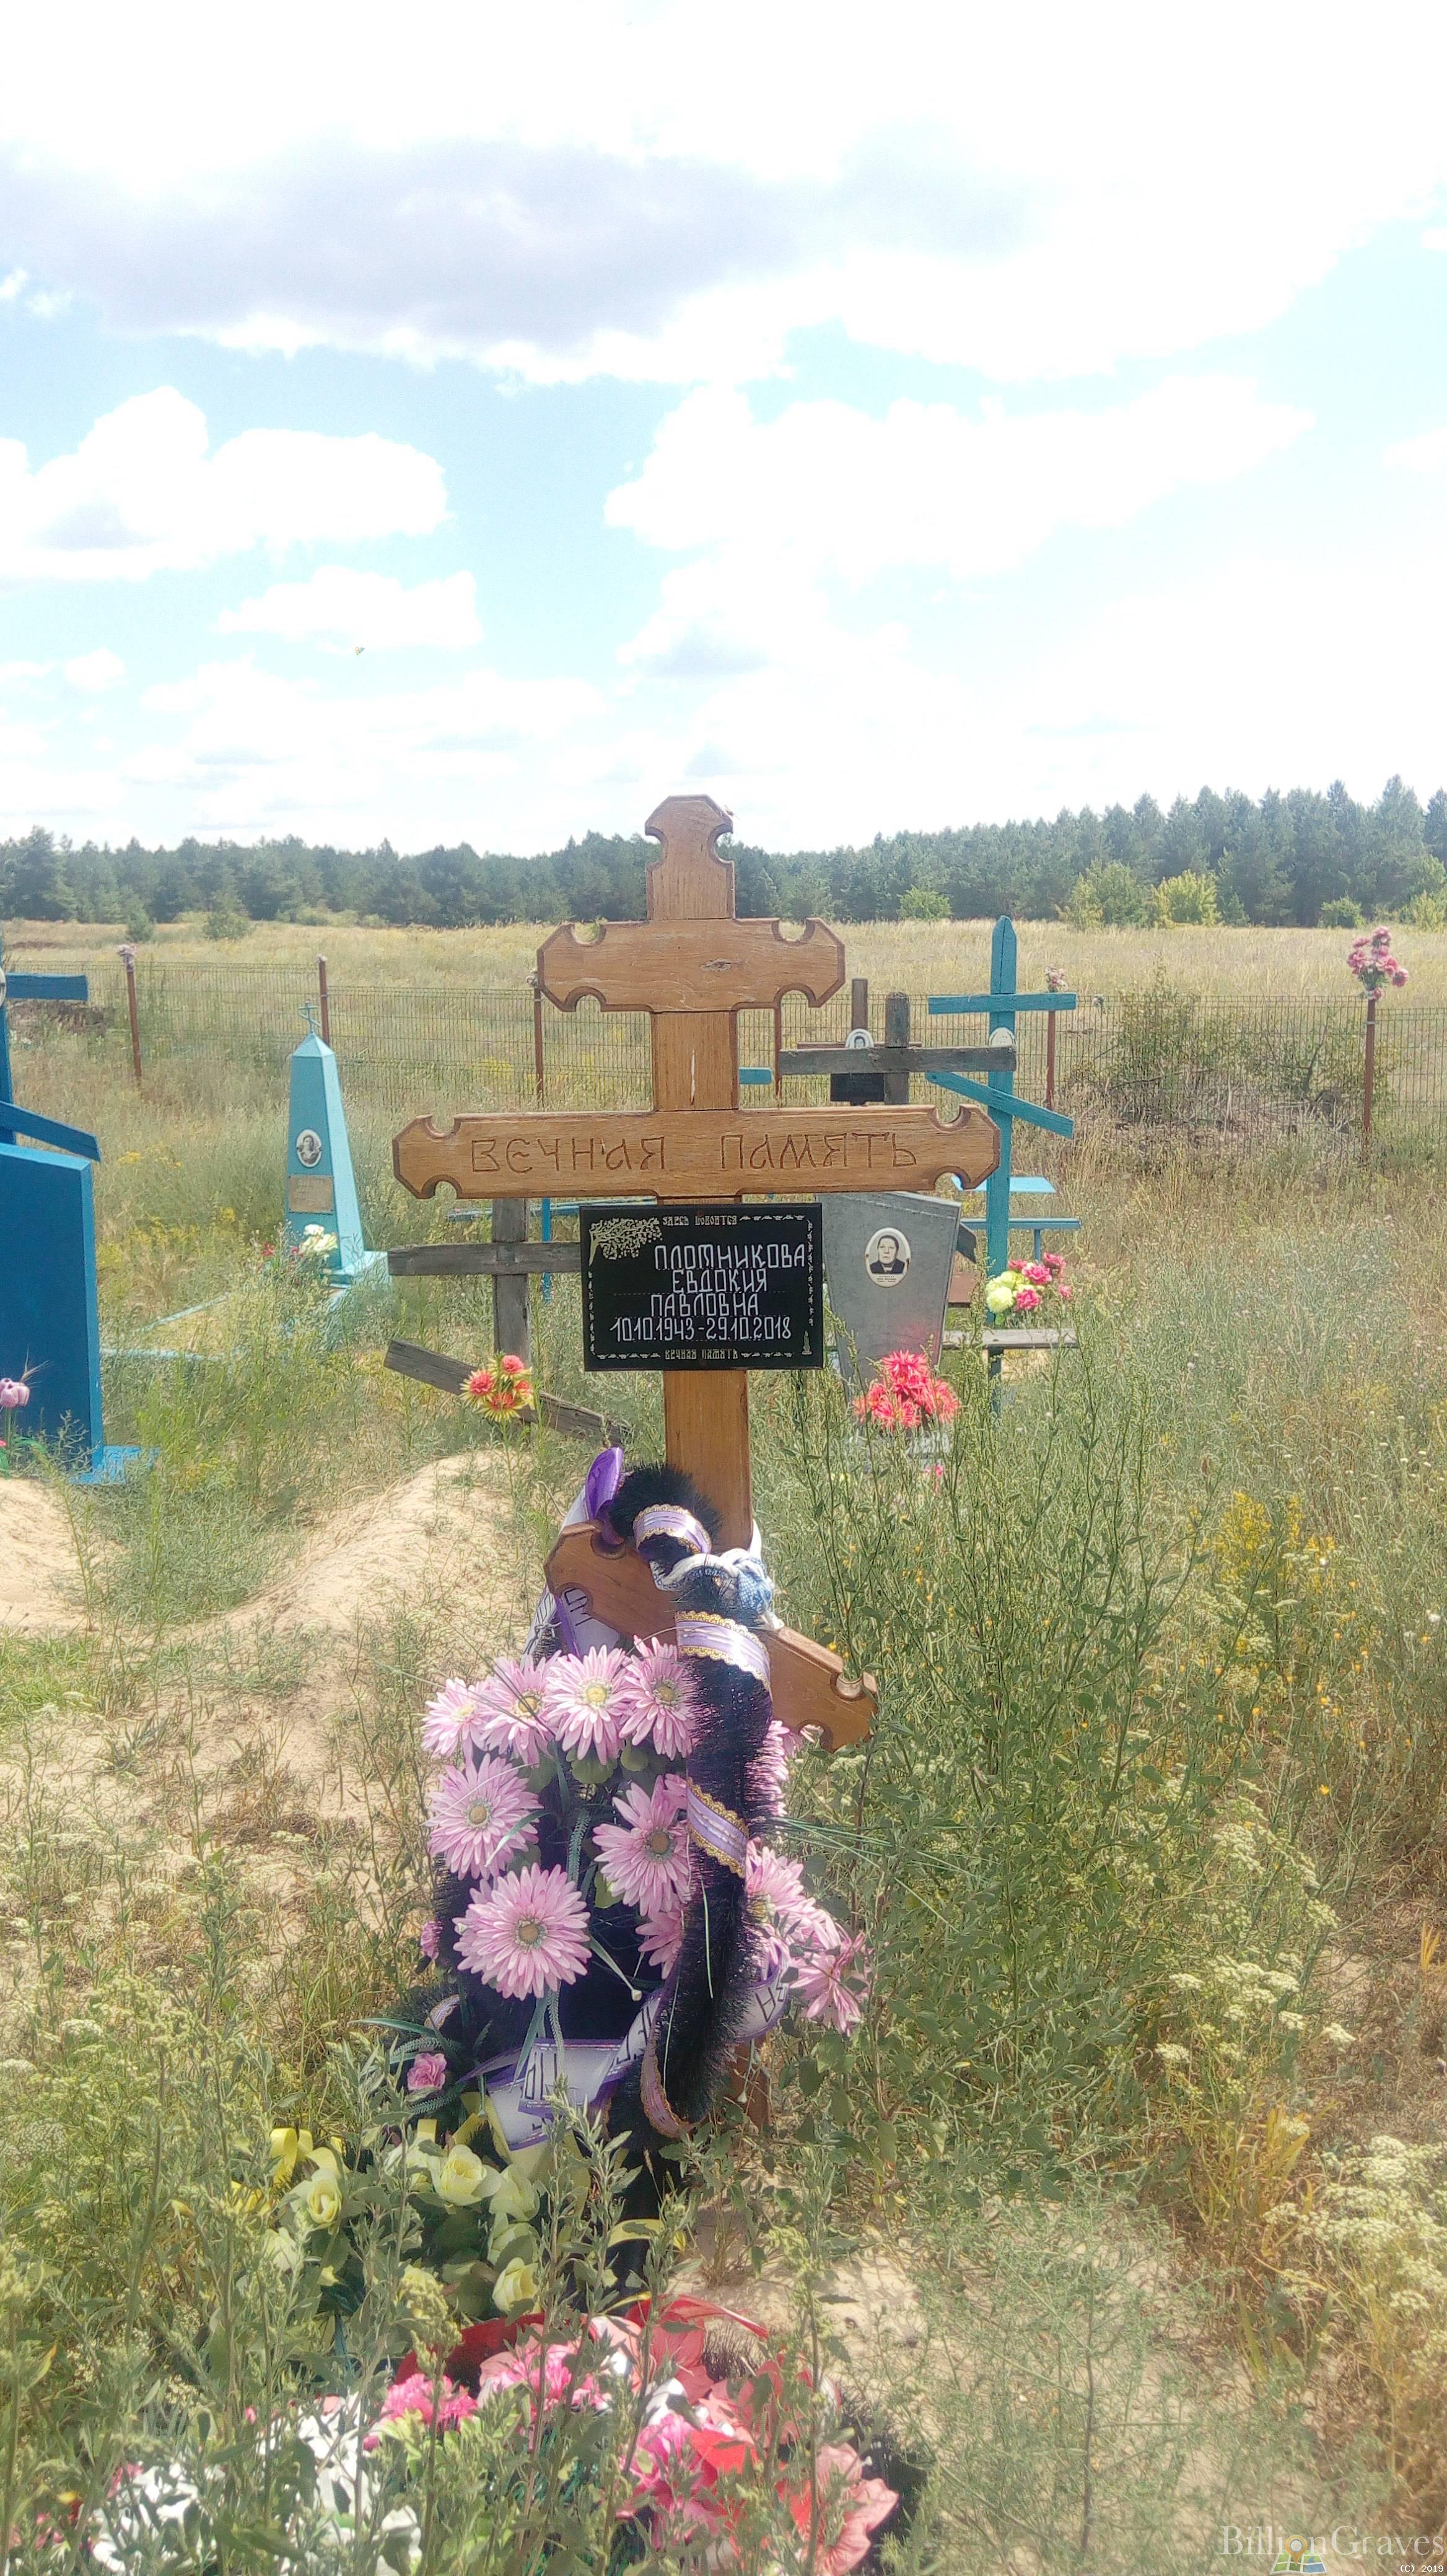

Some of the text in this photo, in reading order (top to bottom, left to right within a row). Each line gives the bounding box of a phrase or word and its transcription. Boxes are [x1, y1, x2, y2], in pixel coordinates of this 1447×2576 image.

[654, 1243, 805, 1270] ПЛОТНИКОВА
[673, 1269, 767, 1294] ЕВДОКИЯ
[650, 1292, 759, 1317] ПАВЛОВНА
